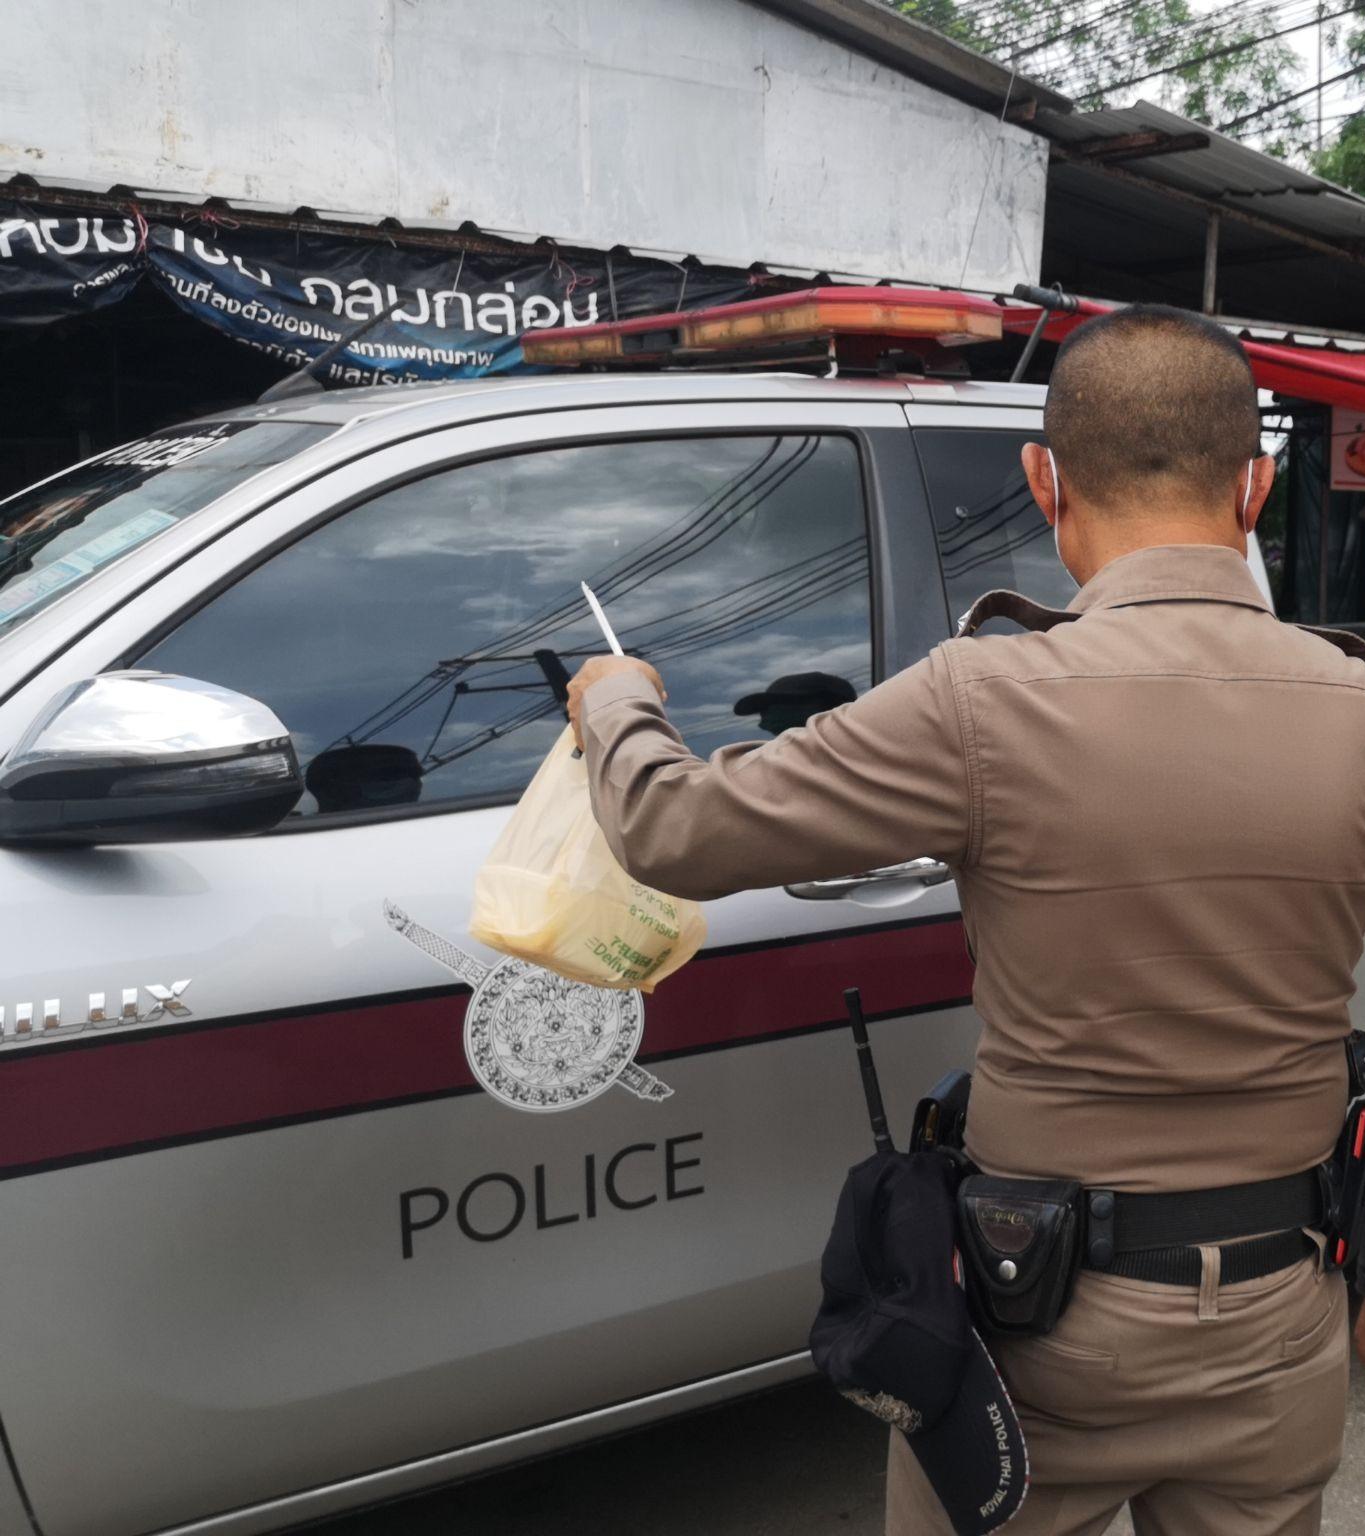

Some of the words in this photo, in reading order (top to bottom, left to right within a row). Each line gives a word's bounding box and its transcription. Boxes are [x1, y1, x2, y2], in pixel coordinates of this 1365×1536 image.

[399, 1132, 706, 1259] POLICE
[986, 1402, 1010, 1451] POLICE
[999, 1455, 1012, 1485] THAI
[980, 1489, 1007, 1518] ROYAL
